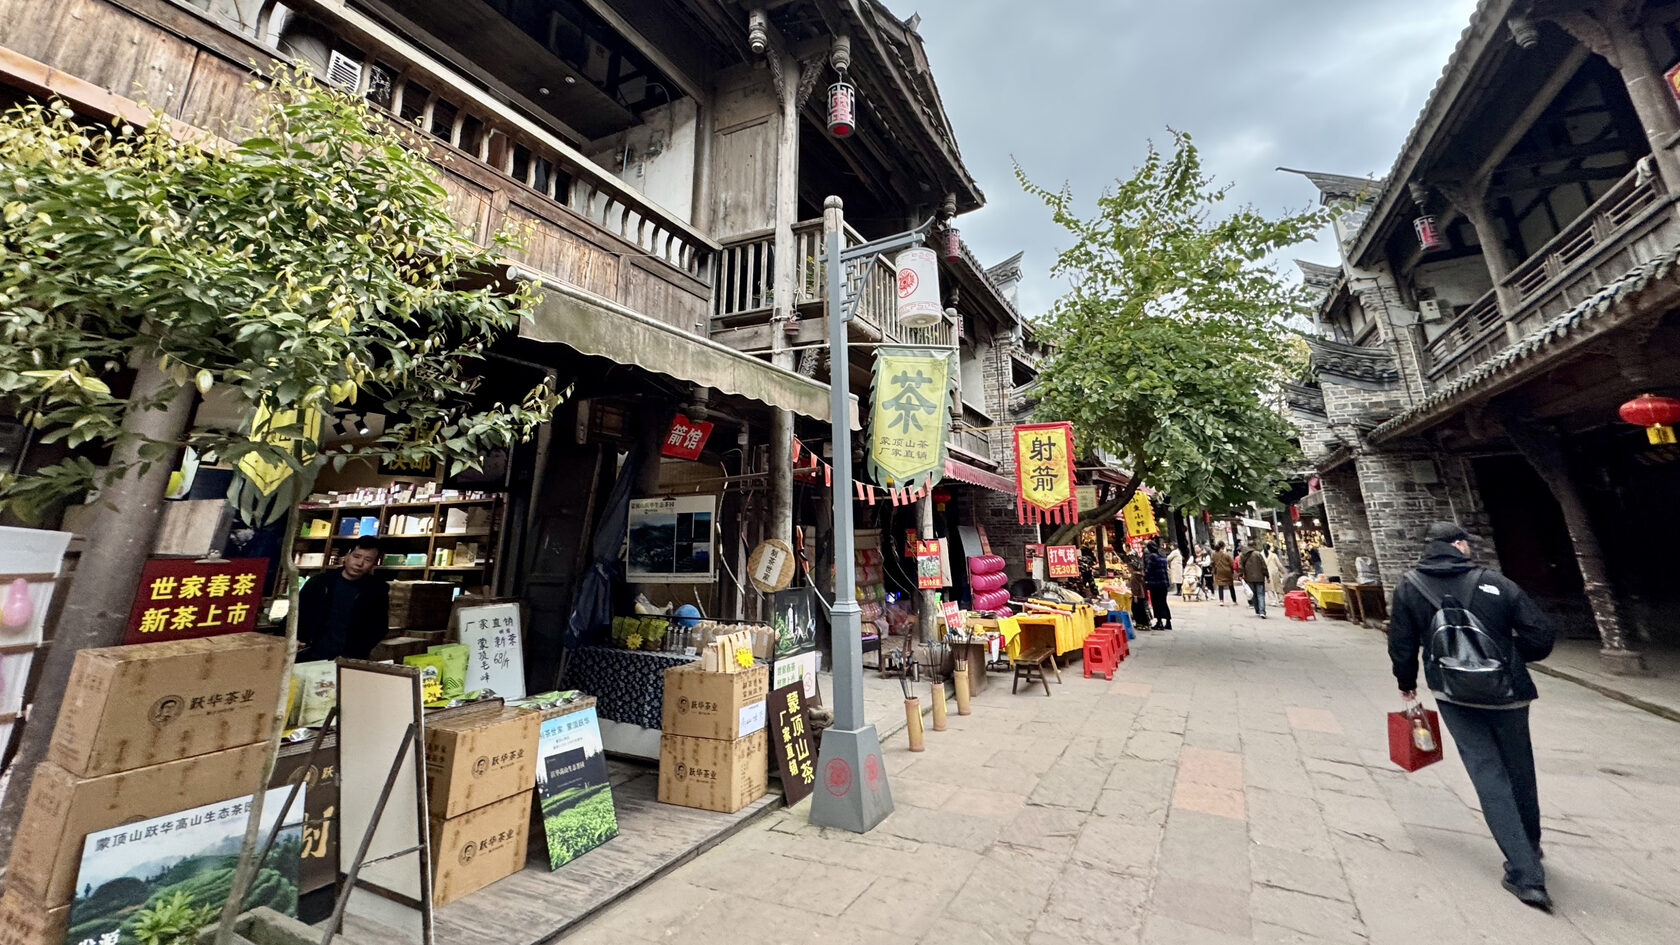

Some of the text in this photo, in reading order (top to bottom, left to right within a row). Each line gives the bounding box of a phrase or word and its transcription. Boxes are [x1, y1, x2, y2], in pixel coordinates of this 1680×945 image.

[882, 369, 937, 434] 茶
[668, 424, 702, 450] 箭馆
[880, 437, 928, 448] 蒙顶山茶
[879, 447, 927, 460] 厂家直销
[1029, 437, 1058, 491] 射箭
[1049, 549, 1076, 563] 打气球
[1051, 565, 1078, 574] 5元30发
[150, 573, 257, 600] 世家春茶
[138, 602, 250, 633] 新茶上市
[465, 617, 513, 632] 厂家直销
[189, 689, 256, 710] 跃华茶业
[691, 701, 718, 712] 跃华茶业
[779, 711, 799, 777] 厂家直销
[786, 691, 815, 785] 蒙顶山茶
[491, 748, 525, 767] 跃华茶业
[689, 766, 717, 780] 跃华茶业
[479, 828, 515, 851] 跃华茶业
